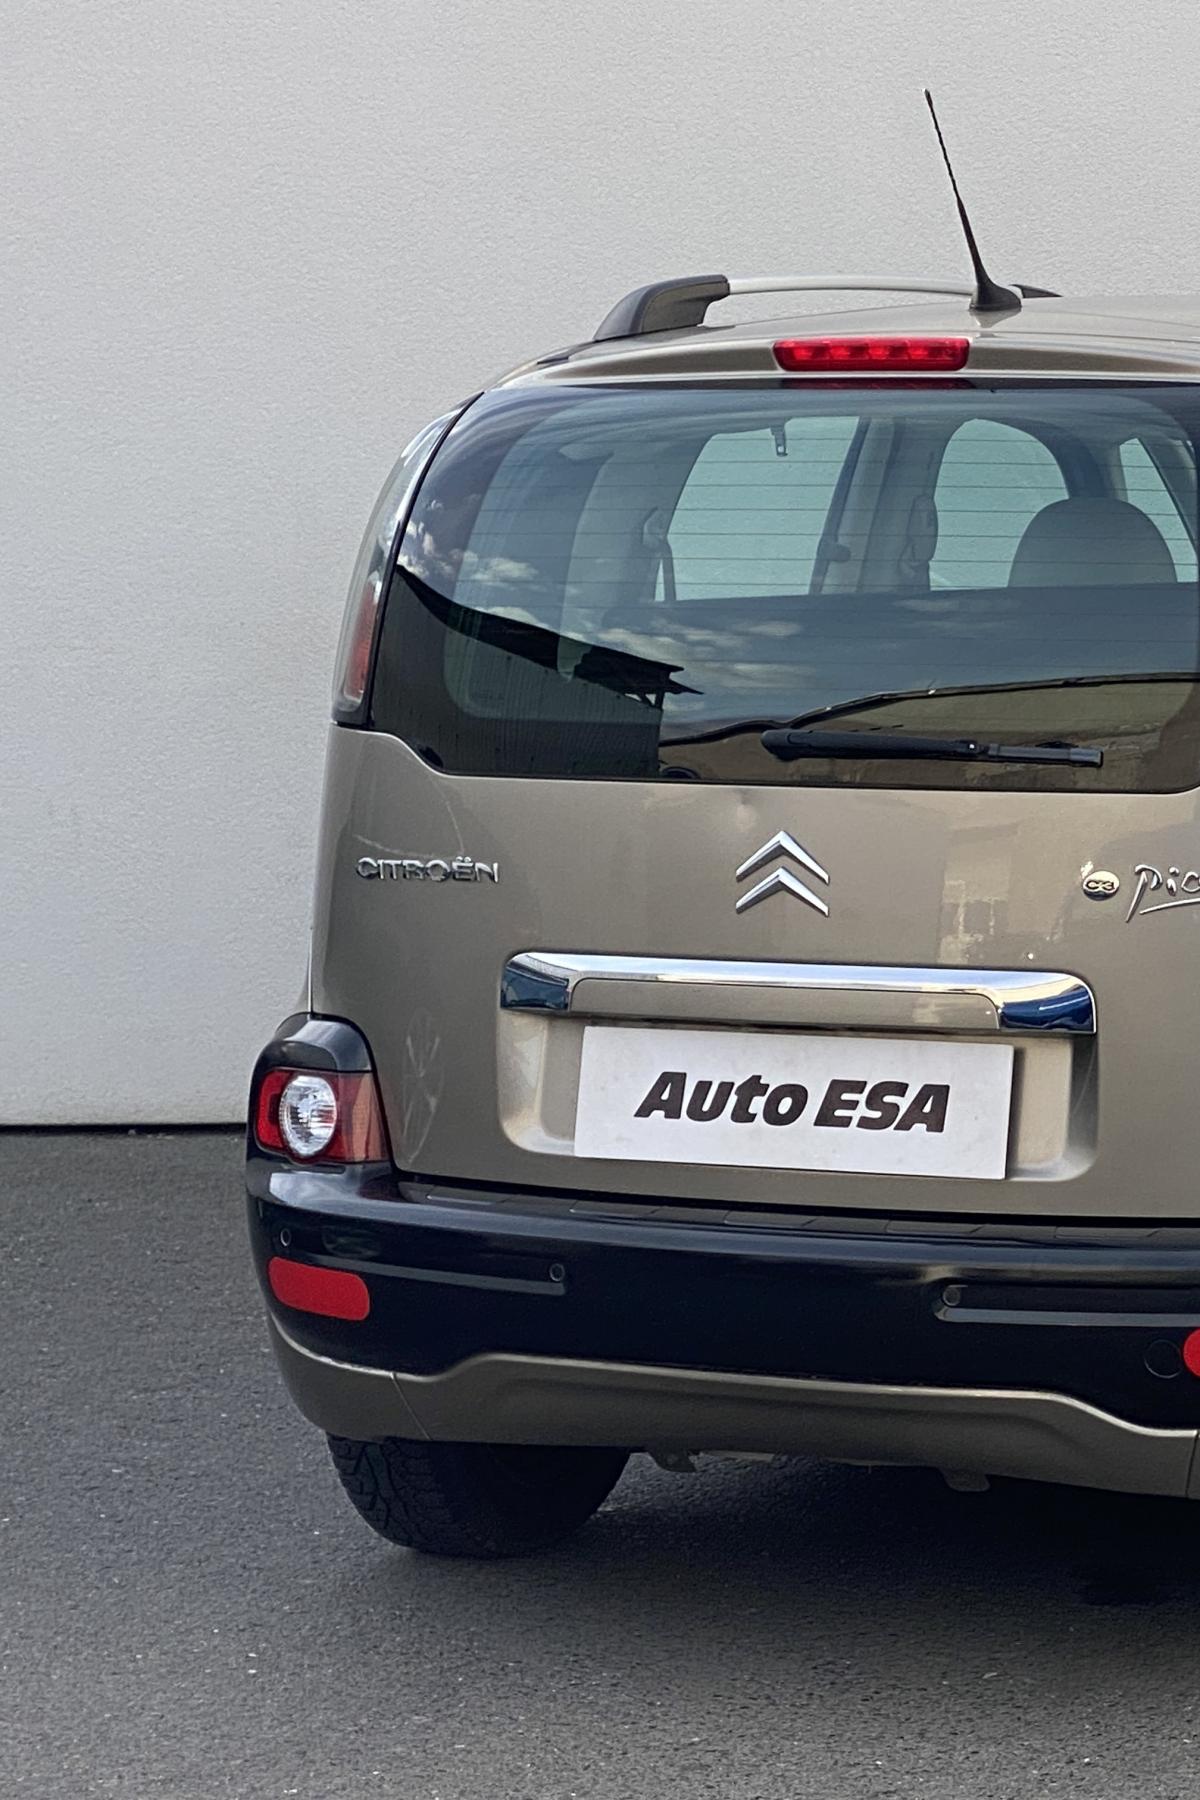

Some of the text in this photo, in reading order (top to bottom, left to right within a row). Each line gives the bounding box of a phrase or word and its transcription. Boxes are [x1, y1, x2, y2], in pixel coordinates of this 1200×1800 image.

[356, 856, 499, 883] CITROËN
[634, 1071, 951, 1133] Auto ESA
